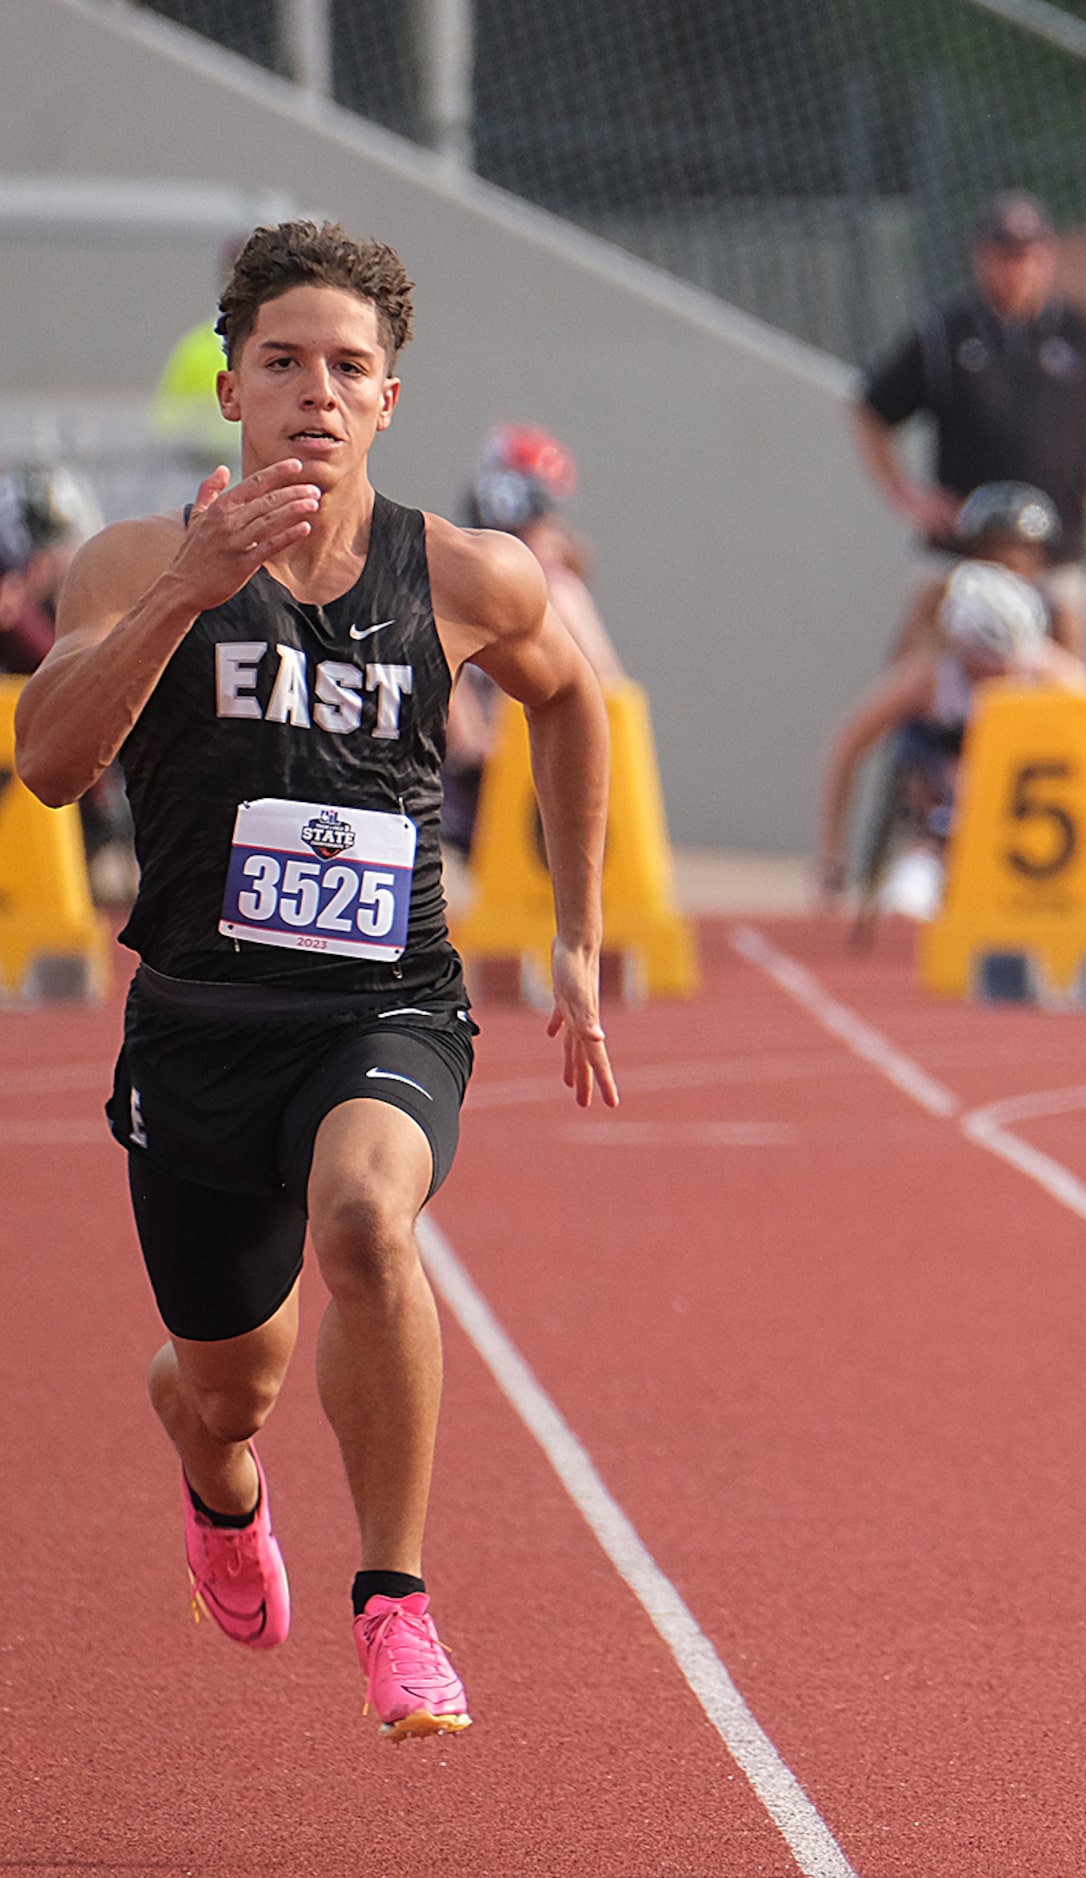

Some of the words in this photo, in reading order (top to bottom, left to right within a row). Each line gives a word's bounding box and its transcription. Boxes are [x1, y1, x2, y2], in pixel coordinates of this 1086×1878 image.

[216, 641, 413, 740] EAST
[302, 827, 355, 846] STATE
[1006, 758, 1079, 881] 5
[238, 855, 396, 938] 3525
[296, 936, 329, 950] 2023
